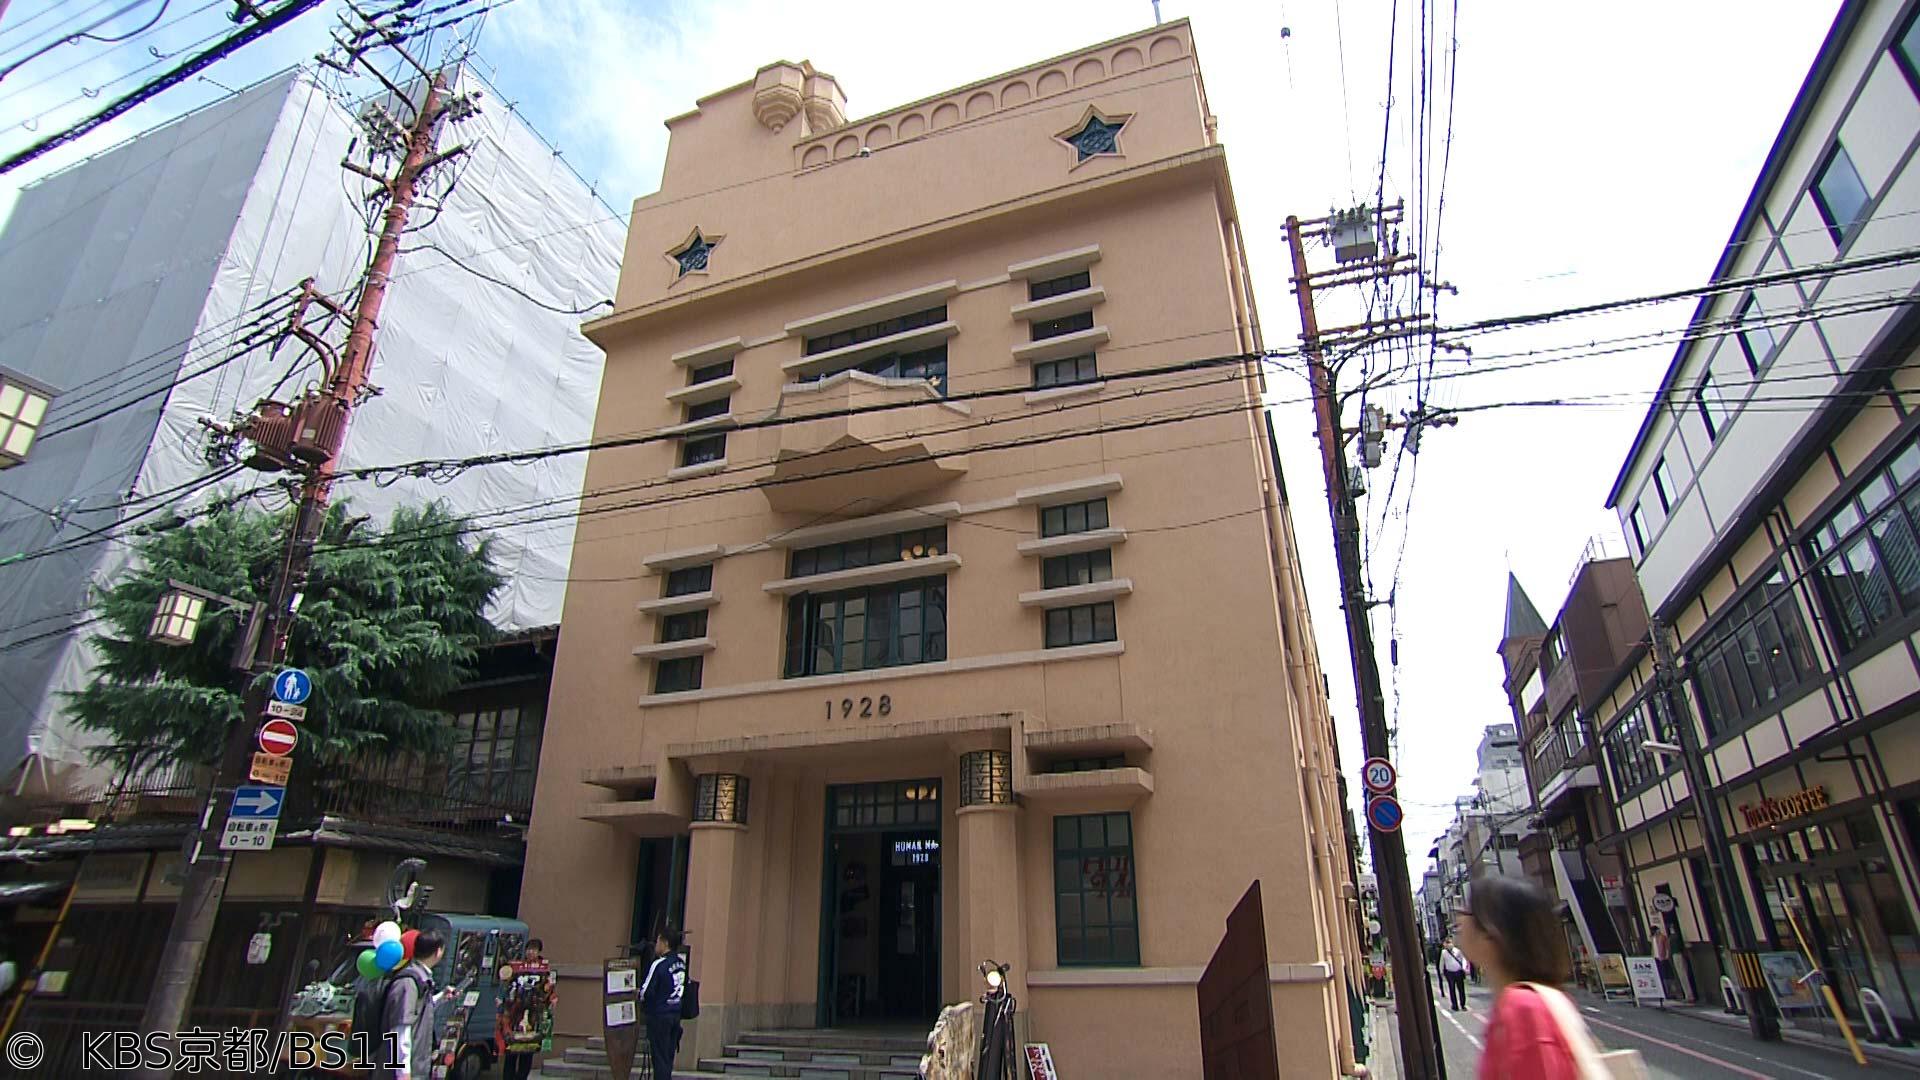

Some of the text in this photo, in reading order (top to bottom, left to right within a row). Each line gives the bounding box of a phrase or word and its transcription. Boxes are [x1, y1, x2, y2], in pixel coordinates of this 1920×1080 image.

[825, 694, 891, 720] 1928
[1369, 767, 1389, 784] 20
[1779, 784, 1826, 820] COFFEE
[895, 840, 922, 852] HUMAN
[912, 853, 929, 864] 1928
